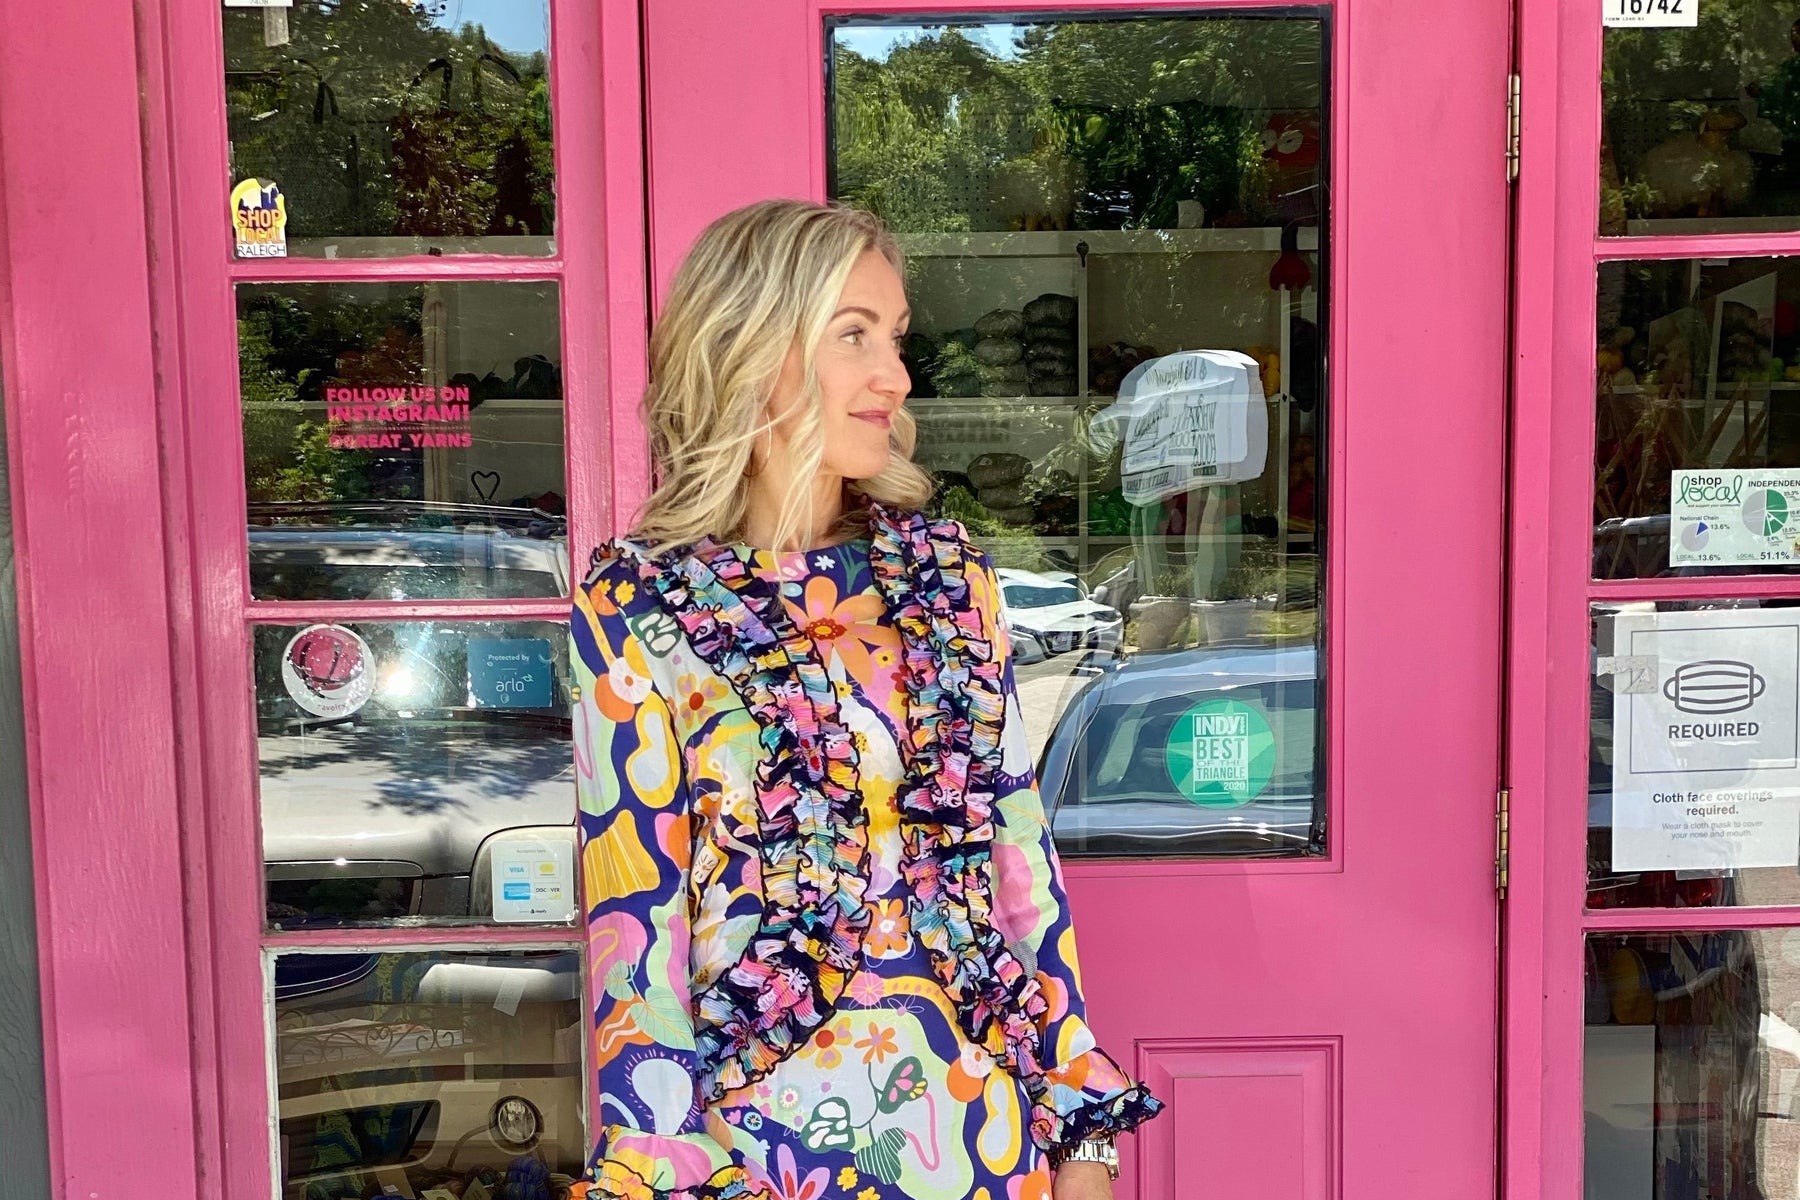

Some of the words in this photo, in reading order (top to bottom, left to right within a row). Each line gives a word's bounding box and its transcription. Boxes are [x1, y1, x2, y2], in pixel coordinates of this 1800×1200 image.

[237, 209, 282, 229] SHOP
[237, 227, 284, 244] LOCAL
[237, 245, 286, 256] RALEIGH
[326, 387, 406, 403] FOLLOW
[411, 386, 436, 401] US
[440, 386, 470, 401] ON
[328, 404, 470, 423] INSTAGRAM!
[1690, 475, 1722, 487] shop
[1676, 475, 1743, 504] local
[1711, 523, 1731, 531] 13.6%
[1760, 551, 1790, 560] 51.1%
[521, 654, 531, 662] by
[495, 677, 526, 692] arlo
[1196, 716, 1240, 735] INDY
[1668, 722, 1760, 740] REQUIRED
[1196, 739, 1245, 760] BEST
[1196, 766, 1246, 779] TRIANGLE
[1223, 782, 1246, 791] 2020
[1653, 793, 1684, 803] Cloth
[1687, 792, 1713, 802] face
[1716, 790, 1773, 802] coverings
[1686, 805, 1739, 817] required.
[1690, 821, 1709, 829] cloth
[1671, 832, 1688, 840] your
[1709, 830, 1725, 838] and
